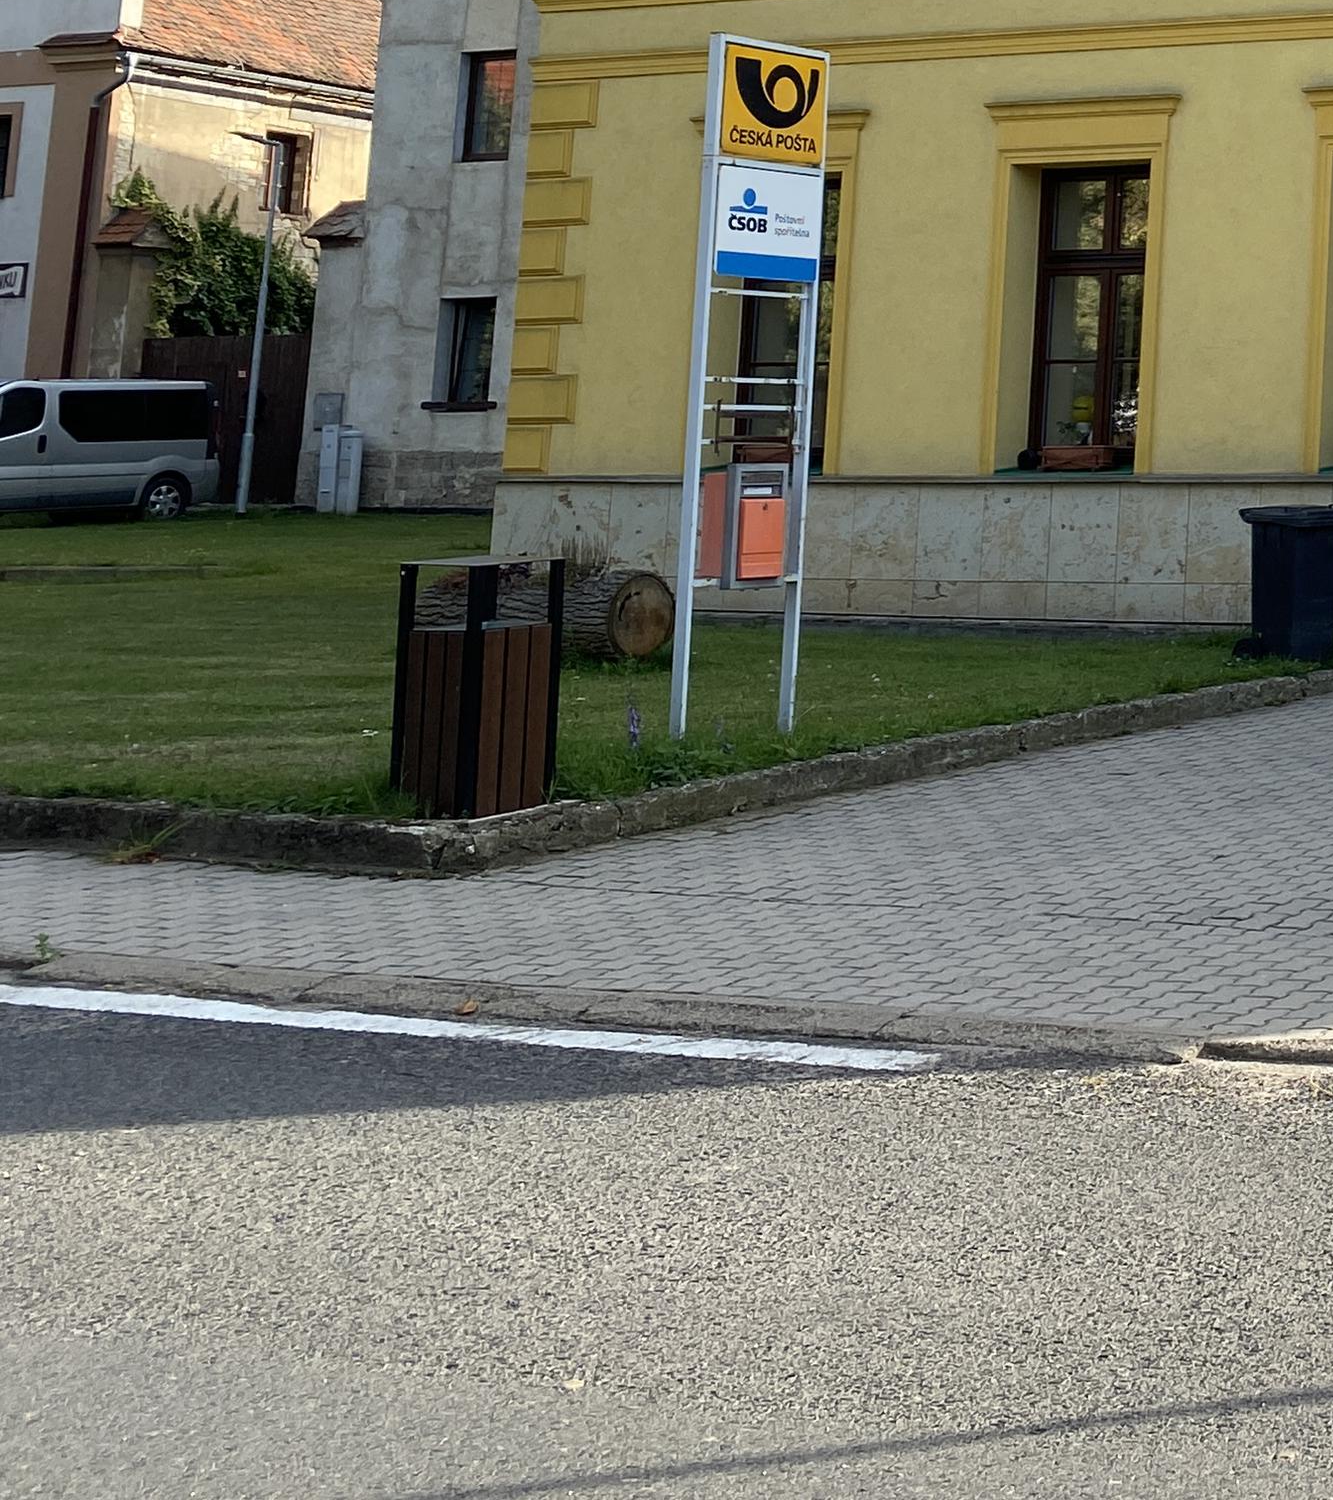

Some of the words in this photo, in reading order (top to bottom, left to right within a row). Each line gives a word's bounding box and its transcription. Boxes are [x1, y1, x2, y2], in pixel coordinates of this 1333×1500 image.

[729, 125, 773, 148] ČESKÁ
[775, 133, 817, 153] POŠTA
[728, 213, 768, 233] ČSOB
